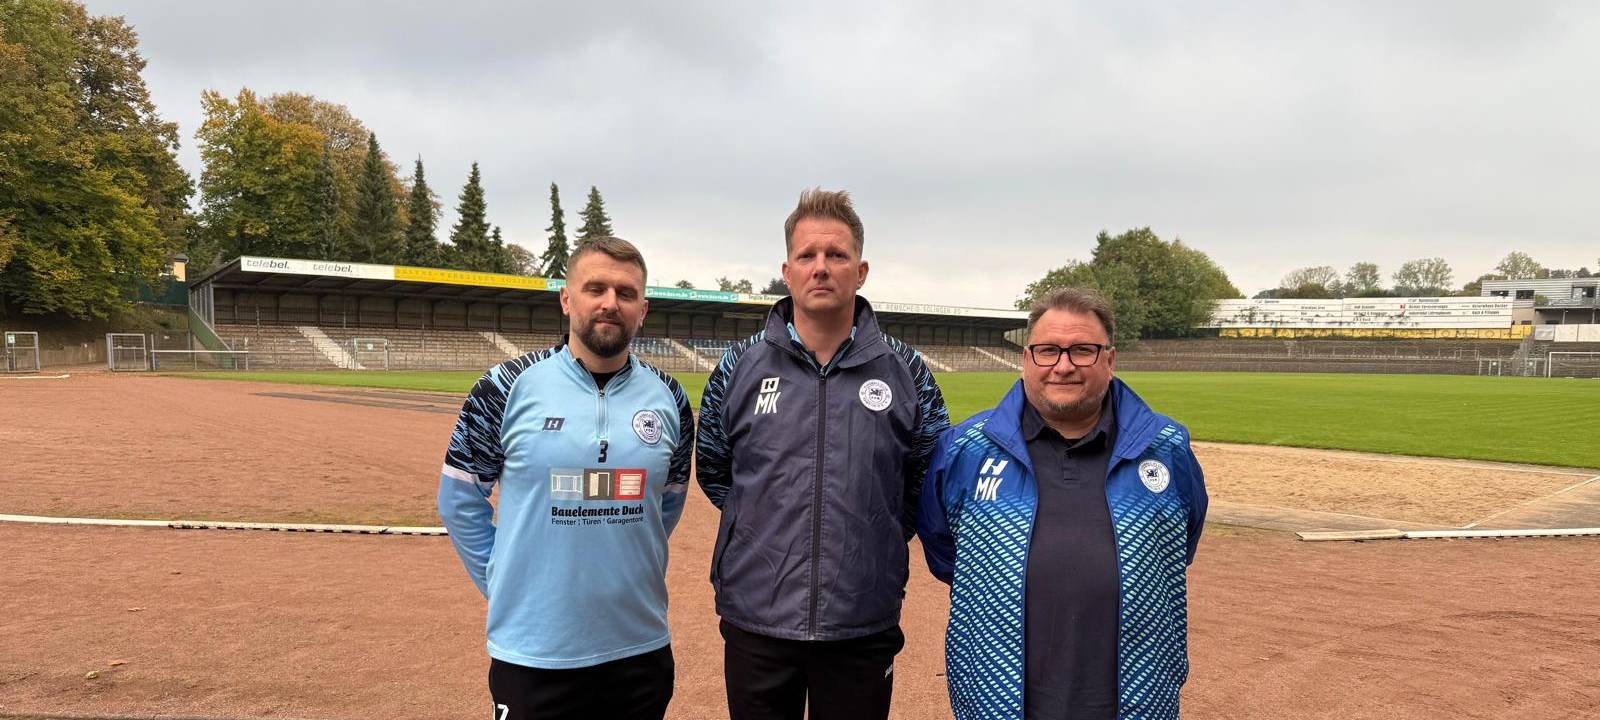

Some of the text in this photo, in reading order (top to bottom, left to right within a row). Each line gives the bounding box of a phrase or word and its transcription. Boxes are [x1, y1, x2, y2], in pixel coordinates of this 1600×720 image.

[754, 392, 781, 415] MK
[598, 440, 609, 463] 3
[974, 476, 1003, 501] MK
[551, 504, 644, 517] Bauelemente Duck
[551, 518, 576, 526] Fenster
[606, 516, 644, 526] Garagentore
